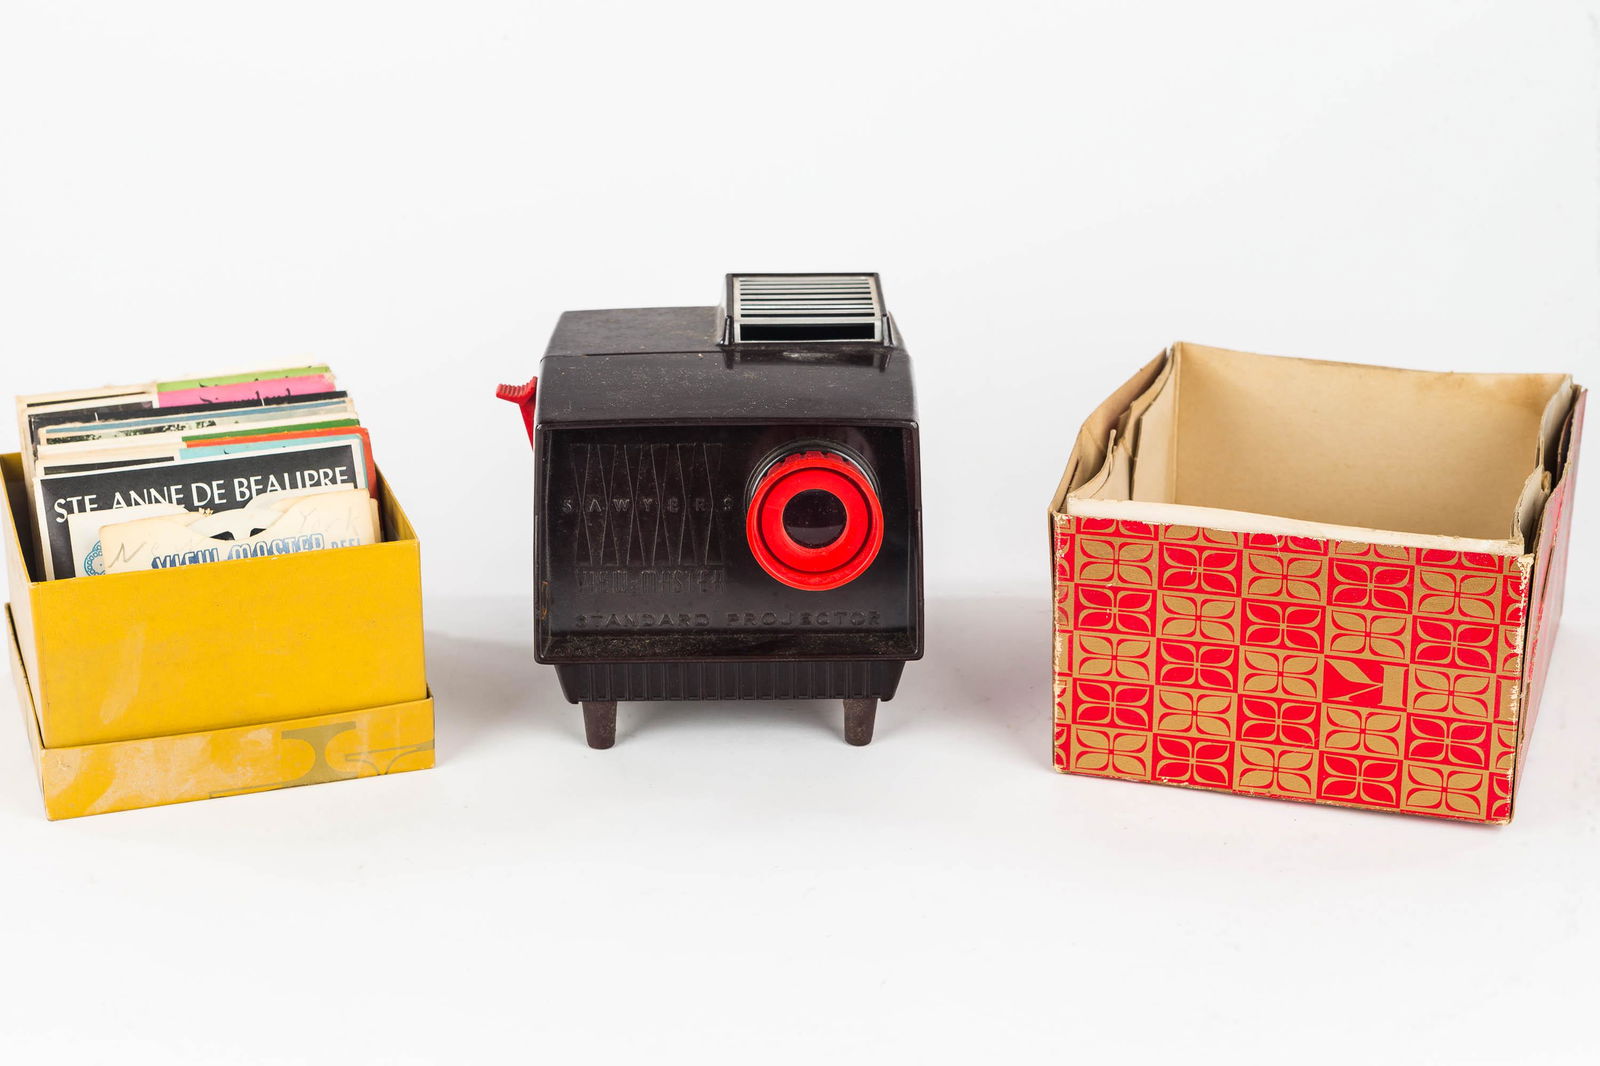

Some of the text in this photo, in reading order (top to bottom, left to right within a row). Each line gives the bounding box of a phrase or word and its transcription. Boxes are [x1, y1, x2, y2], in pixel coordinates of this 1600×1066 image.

[54, 466, 348, 523] STE ANNE DE BEAUPRE
[575, 609, 882, 627] STANDARD PROJECTOR
